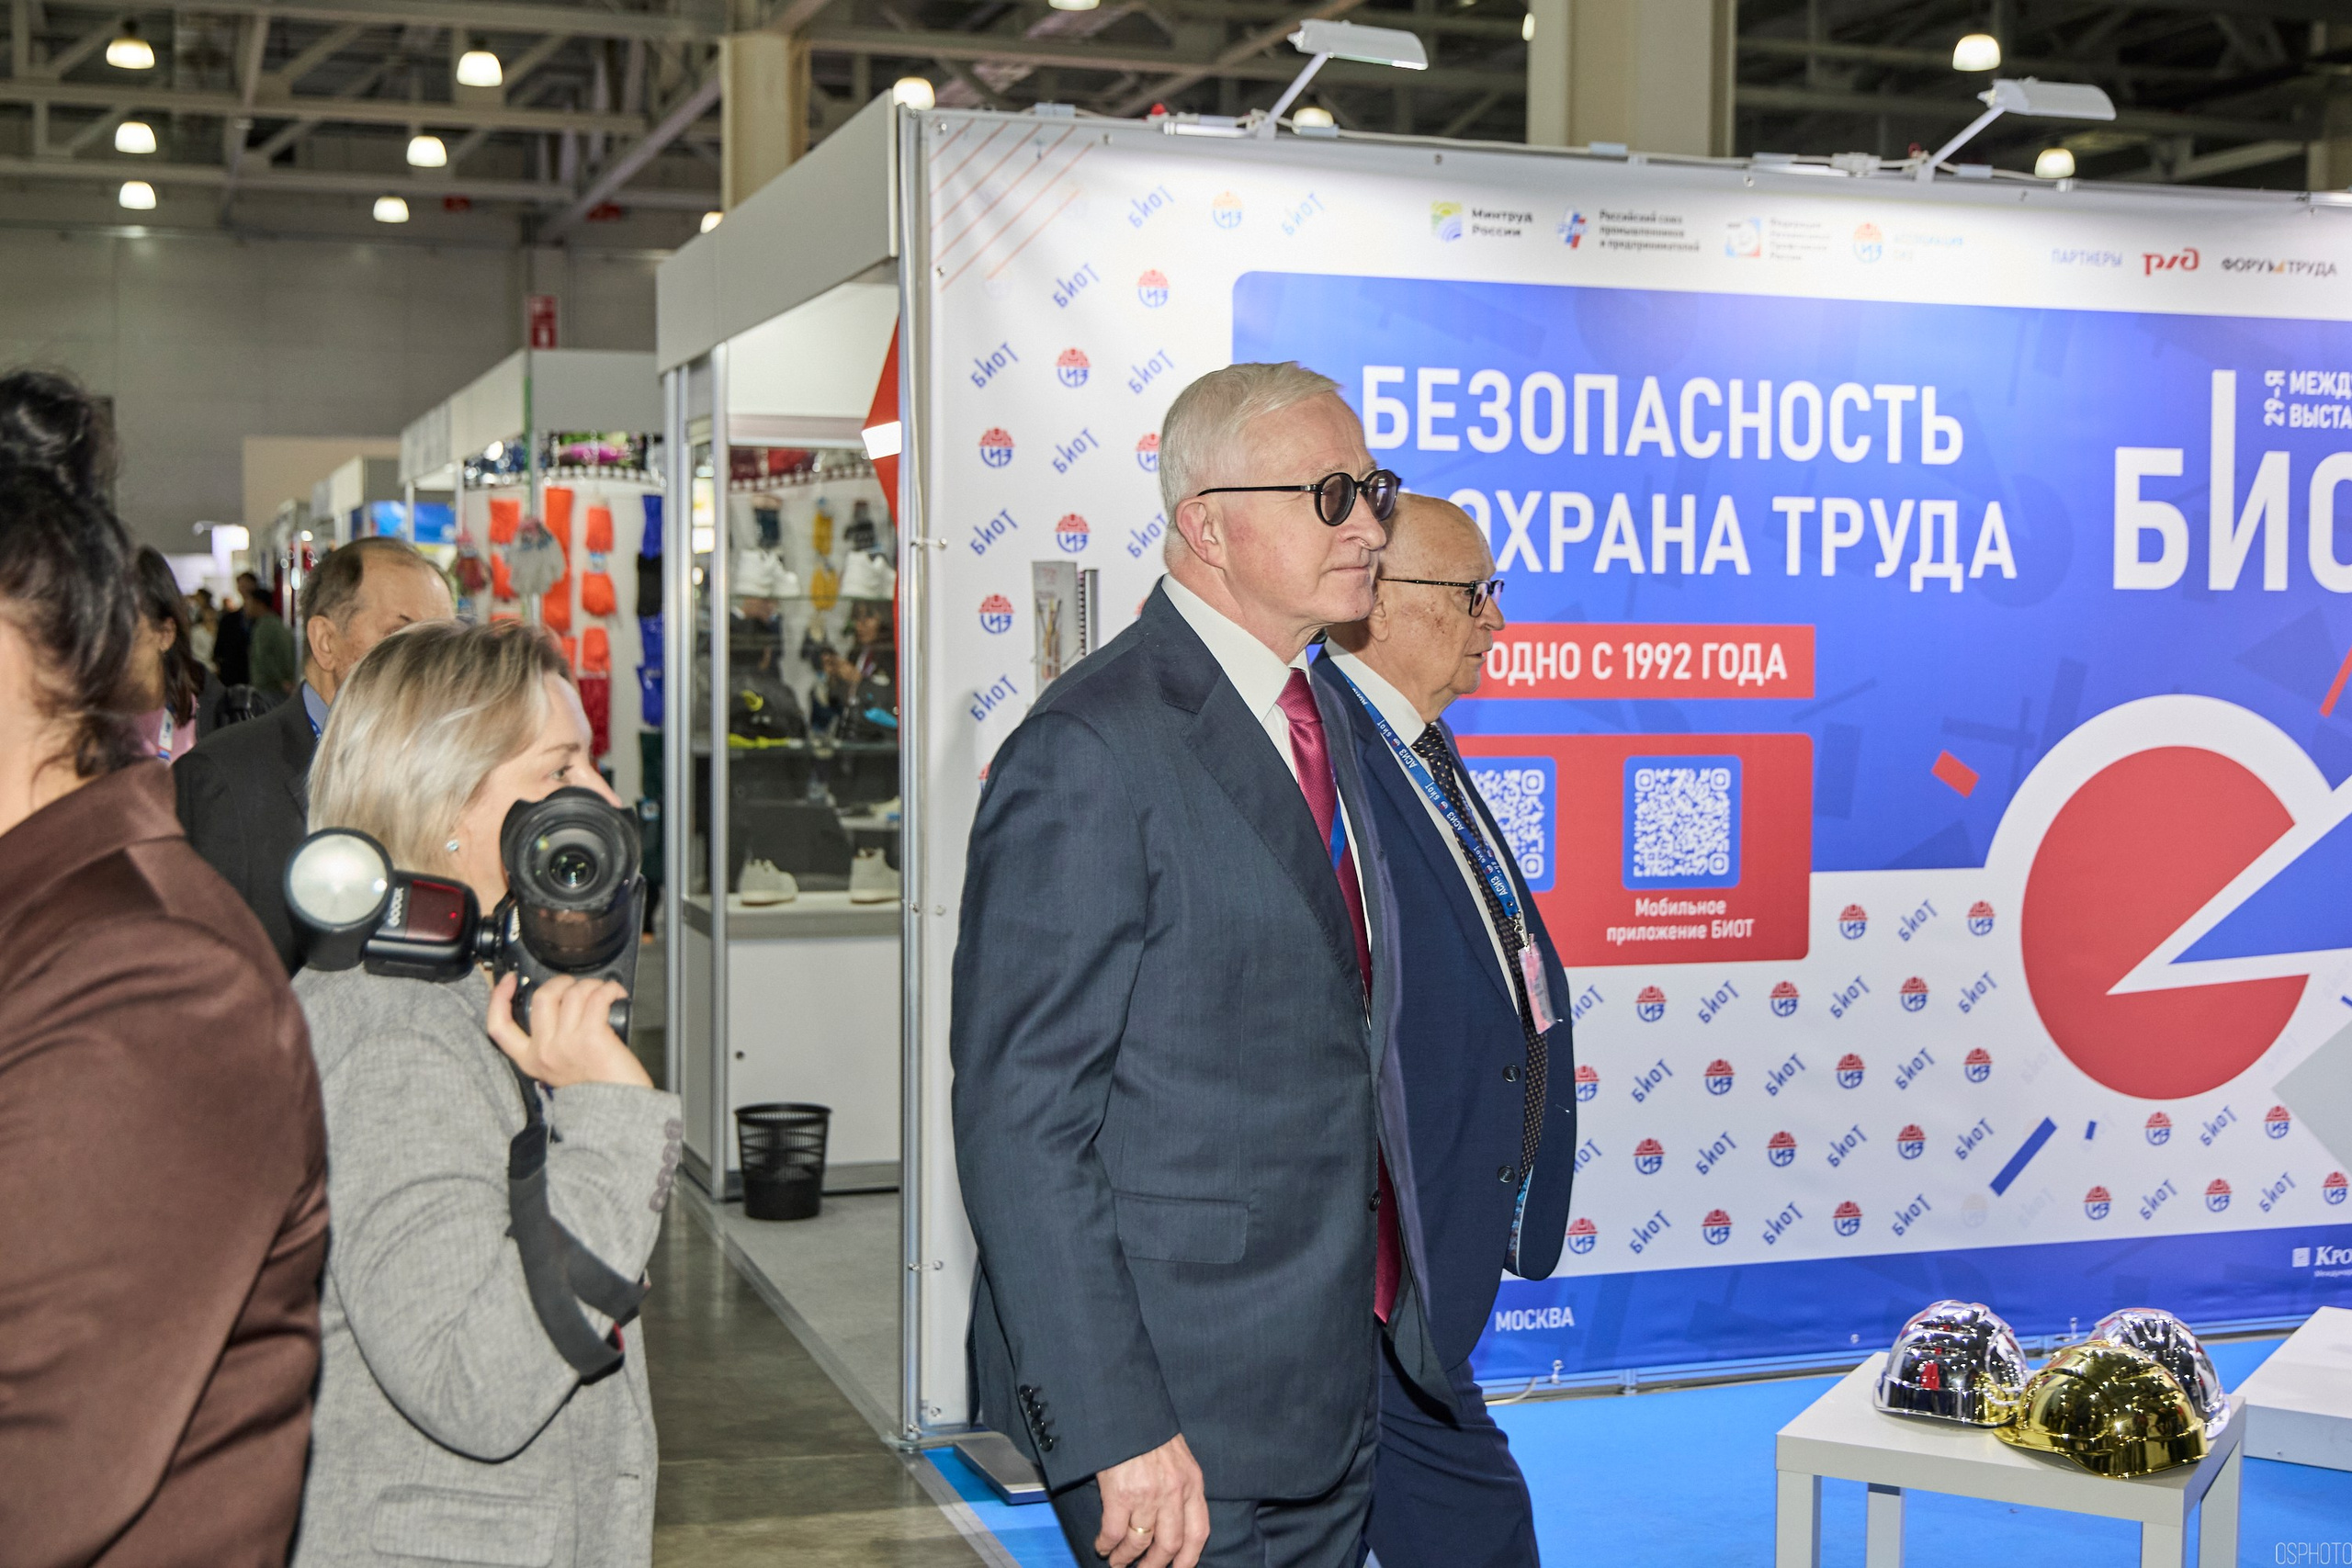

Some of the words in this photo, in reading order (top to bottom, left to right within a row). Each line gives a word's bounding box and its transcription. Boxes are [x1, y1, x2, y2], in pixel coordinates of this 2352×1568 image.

[2289, 369, 2352, 400] МЕЖД
[1362, 366, 1964, 466] БЕЗОПАСНОСТЬ
[1772, 496, 2018, 593] ТРУДА
[1591, 641, 1613, 681] С
[1623, 641, 1692, 681] 1992
[1702, 642, 1788, 687] ГОДА
[1398, 748, 1418, 769] АСИЗ
[1446, 811, 1464, 831] АСИЗ
[1634, 897, 1727, 917] Мобильное
[1606, 923, 1708, 946] приложение
[1711, 918, 1755, 939] БИОТ
[1571, 985, 1604, 1028] ИОТ
[1495, 1306, 1576, 1332] МОСКВА
